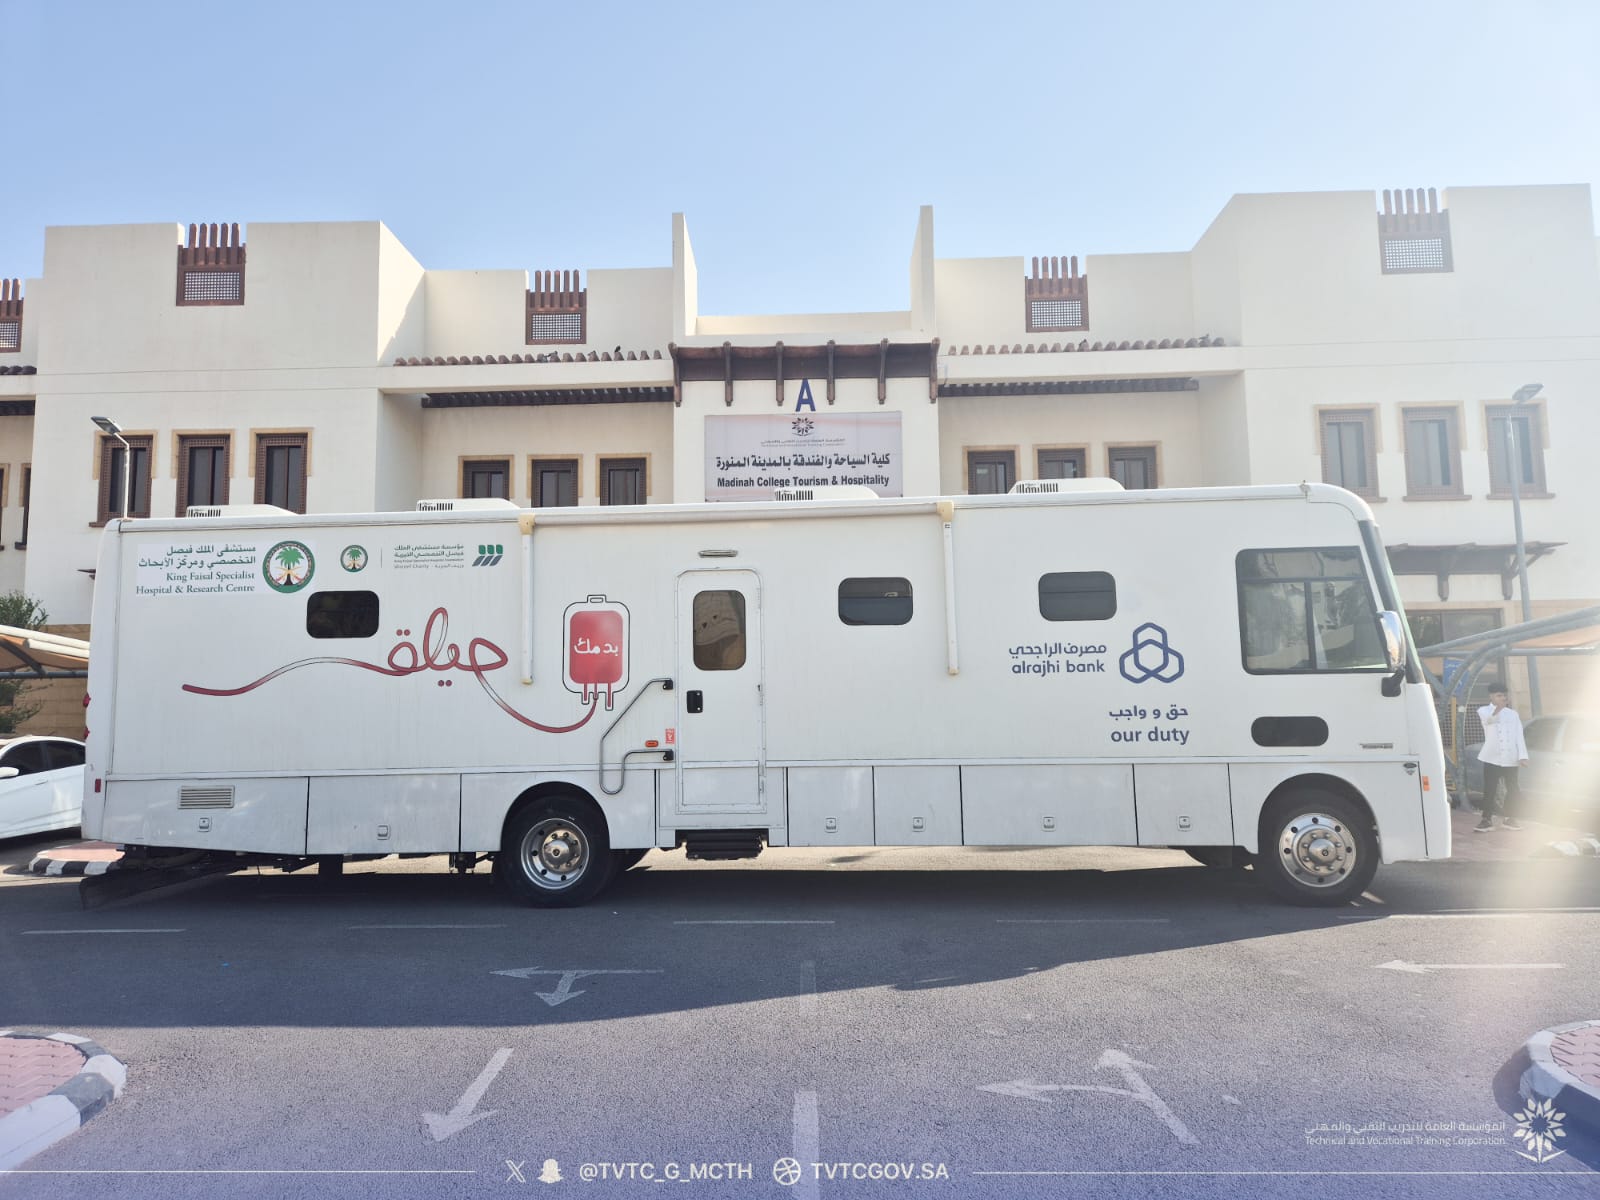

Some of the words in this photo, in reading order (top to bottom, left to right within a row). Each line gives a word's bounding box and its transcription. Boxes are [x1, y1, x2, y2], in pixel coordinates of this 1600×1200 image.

[795, 378, 816, 412] A
[716, 456, 750, 471] المنورة
[751, 455, 791, 471] بالمدينة
[792, 454, 833, 469] والفندقة
[833, 453, 870, 469] السياحة
[871, 453, 891, 468] كلية
[717, 477, 755, 488] Madinah
[756, 476, 791, 488] College
[792, 476, 829, 487] Tourism
[831, 475, 838, 486] &
[840, 475, 890, 487] Hospitality
[166, 545, 193, 557] فيصل
[195, 545, 214, 554] الملك
[216, 543, 256, 557] مستشفى
[176, 556, 204, 569] ومركز
[207, 556, 256, 569] التخصصي
[166, 573, 187, 582] King
[190, 572, 213, 581] Faisal
[216, 571, 255, 582] Specialist
[136, 584, 172, 596] Hospital
[175, 585, 183, 594] &
[186, 584, 223, 594] Research
[225, 583, 255, 592] Centre
[574, 637, 619, 657] بدمك
[1008, 642, 1062, 659] الراجحي
[1063, 642, 1107, 657] مصرف
[1011, 660, 1060, 677] alrajhi
[1066, 659, 1105, 673] bank
[1109, 704, 1147, 721] واجب
[1152, 708, 1161, 719] و
[1166, 704, 1189, 721] حق
[1111, 731, 1142, 742] our
[1147, 726, 1190, 745] duty
